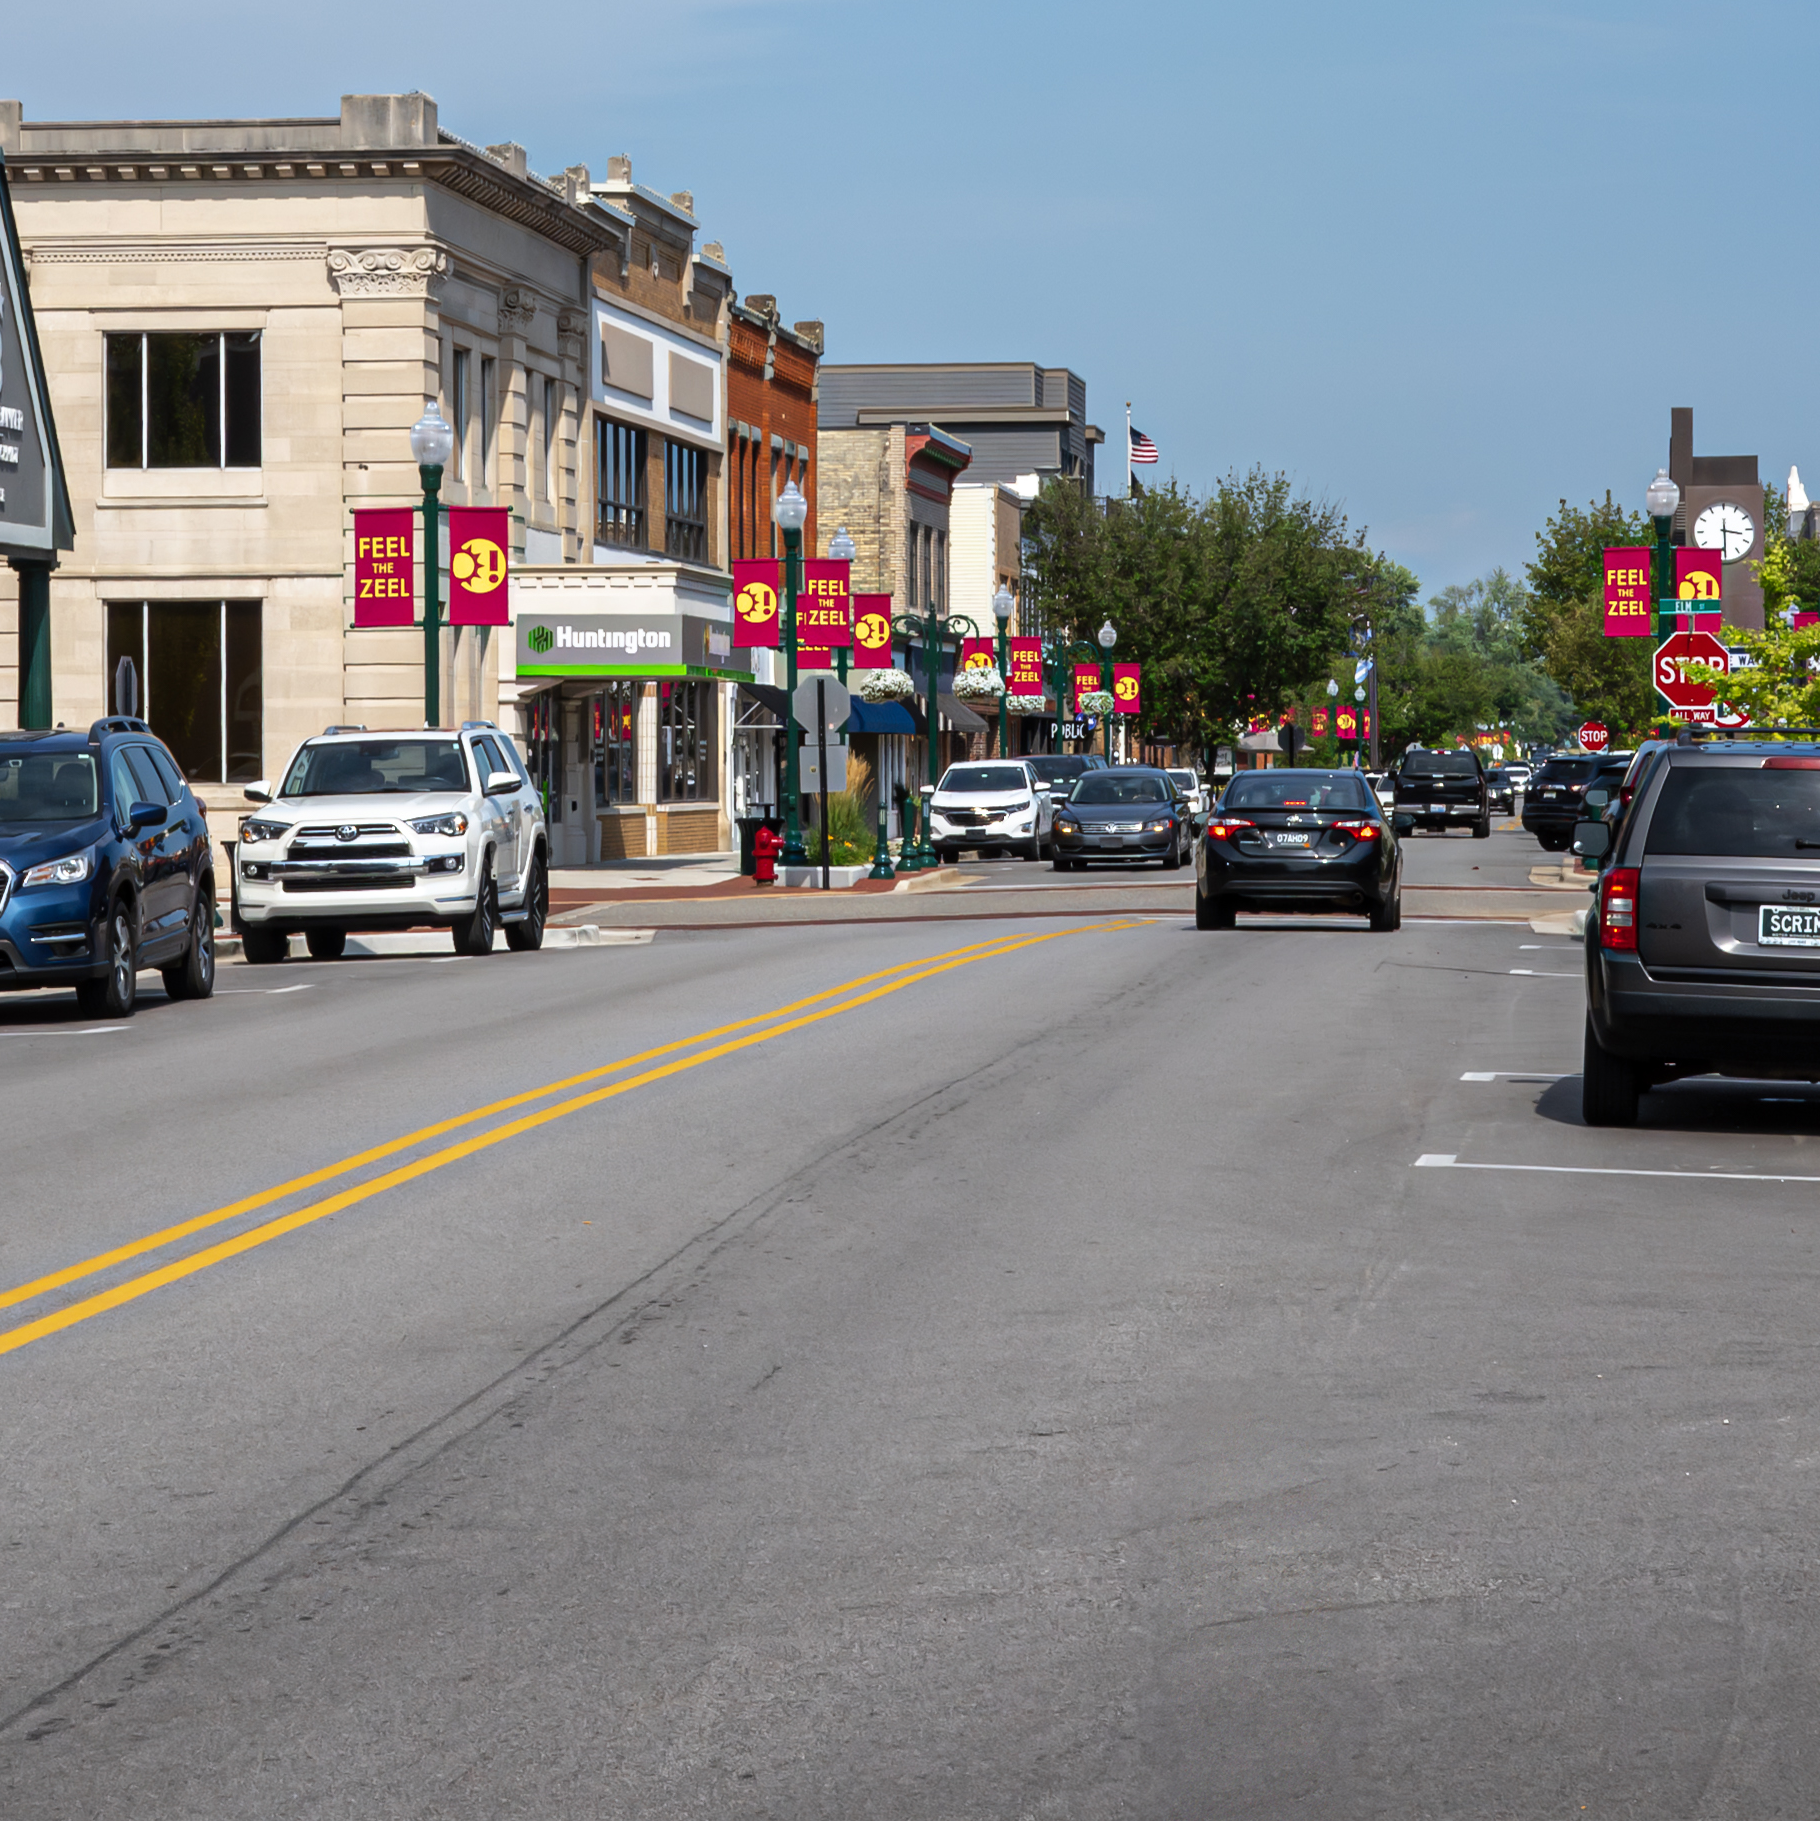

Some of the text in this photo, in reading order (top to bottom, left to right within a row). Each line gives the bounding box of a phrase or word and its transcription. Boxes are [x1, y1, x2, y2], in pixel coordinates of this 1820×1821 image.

[359, 536, 410, 559] FEEL
[372, 562, 394, 574] THE
[1607, 569, 1647, 586] FEEL
[359, 578, 410, 598] ZEEL
[808, 579, 847, 596] FEEL
[1617, 588, 1634, 598] THE
[818, 598, 835, 608] THE
[1608, 600, 1647, 616] ZEEL
[1675, 601, 1693, 613] ELM
[808, 610, 847, 626] ZEEL
[556, 626, 671, 654] Huntington
[1013, 650, 1040, 663] FEEL
[1013, 671, 1040, 683] ZEEL
[1076, 675, 1098, 686] FEEL
[1693, 711, 1711, 721] WAY
[1581, 730, 1608, 742] STOP
[1782, 889, 1816, 902] Jeep
